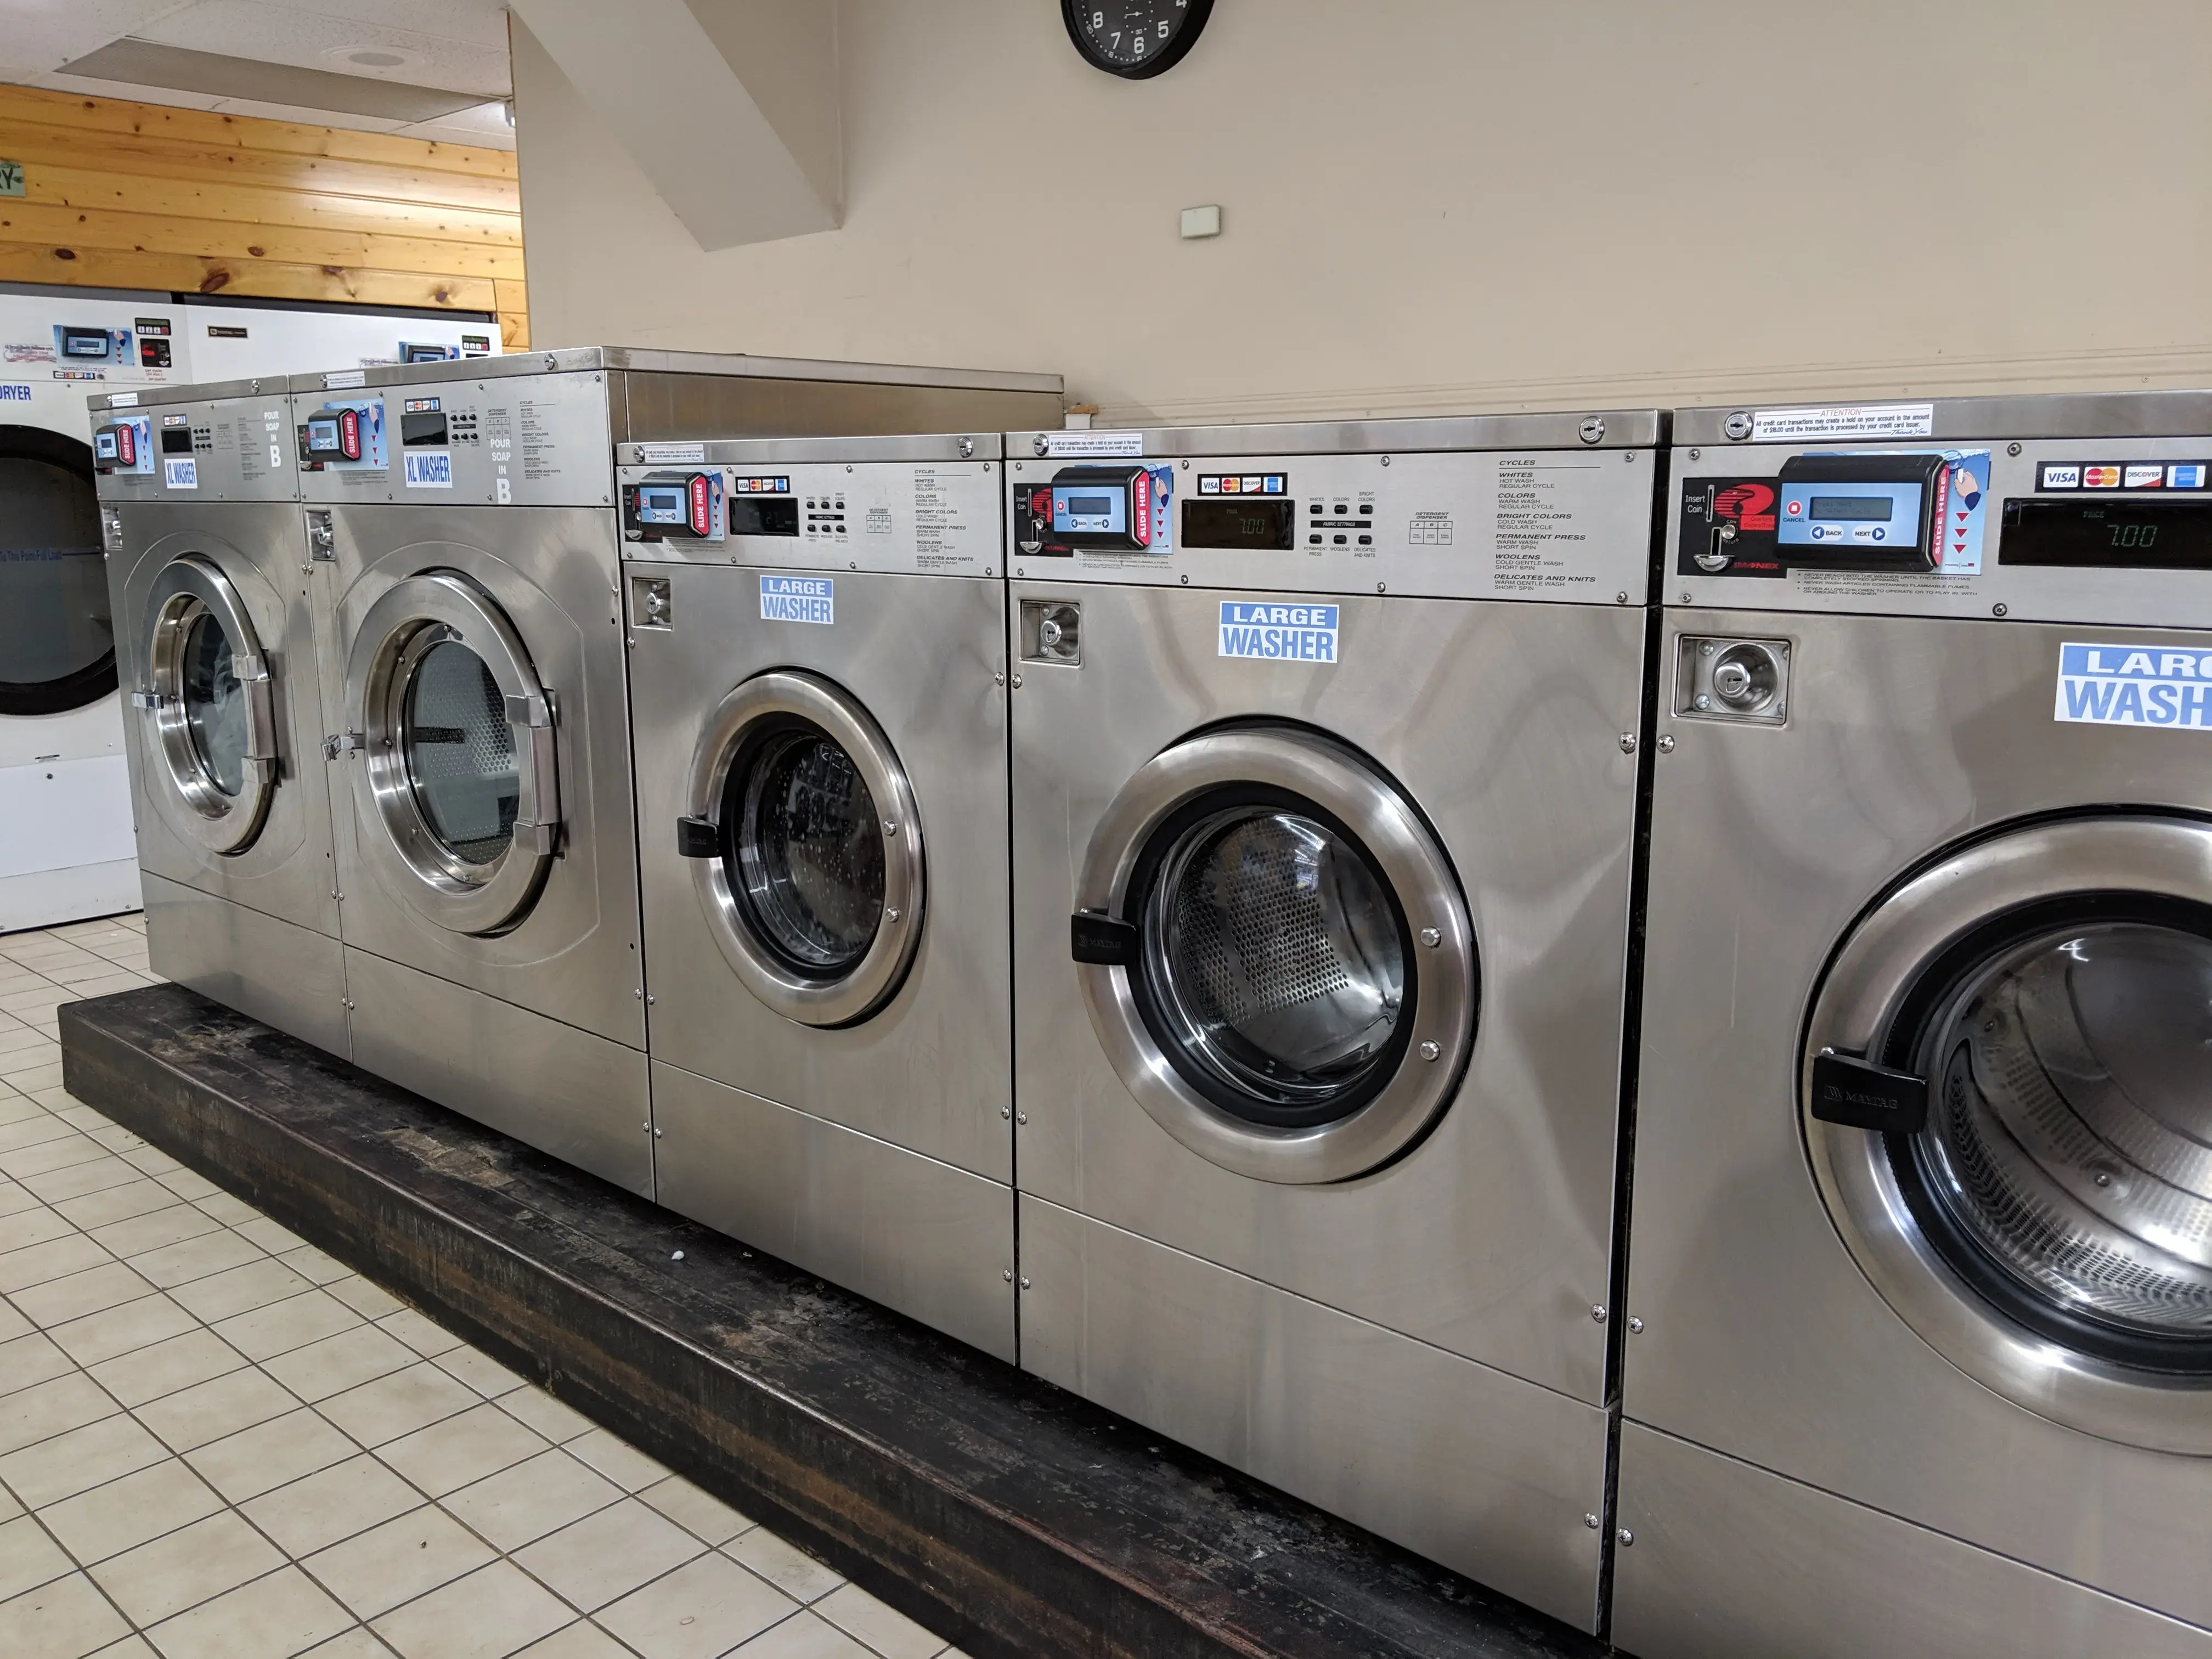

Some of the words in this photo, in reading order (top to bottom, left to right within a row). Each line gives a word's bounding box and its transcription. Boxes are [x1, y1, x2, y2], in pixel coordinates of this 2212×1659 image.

[1093, 11, 1103, 29] 8
[1158, 20, 1169, 38] 5
[1110, 32, 1121, 49] 7
[1134, 36, 1144, 54] 6
[264, 411, 279, 420] POUR
[1820, 408, 1861, 417] ATTENTION
[266, 422, 279, 431] SOAP
[271, 434, 276, 442] IN
[490, 439, 511, 448] POUR
[270, 445, 281, 467] B
[492, 452, 511, 461] SOAP
[166, 463, 174, 484] XL
[174, 462, 195, 484] WASHER
[406, 456, 417, 482] XL
[417, 456, 450, 482] WASHER
[498, 465, 506, 474] IN
[2046, 472, 2077, 483] VISA
[496, 478, 511, 504] B
[1688, 505, 1702, 514] Coin
[1239, 518, 1265, 534] 7.00
[1935, 517, 1943, 554] SLIDE
[2107, 524, 2157, 548] 7.00
[769, 580, 825, 595] LARGE
[763, 596, 831, 622] WASHER
[1234, 606, 1327, 625] LARGE
[1222, 627, 1333, 661] WASHER
[1846, 1091, 1898, 1109] MAYTAG
